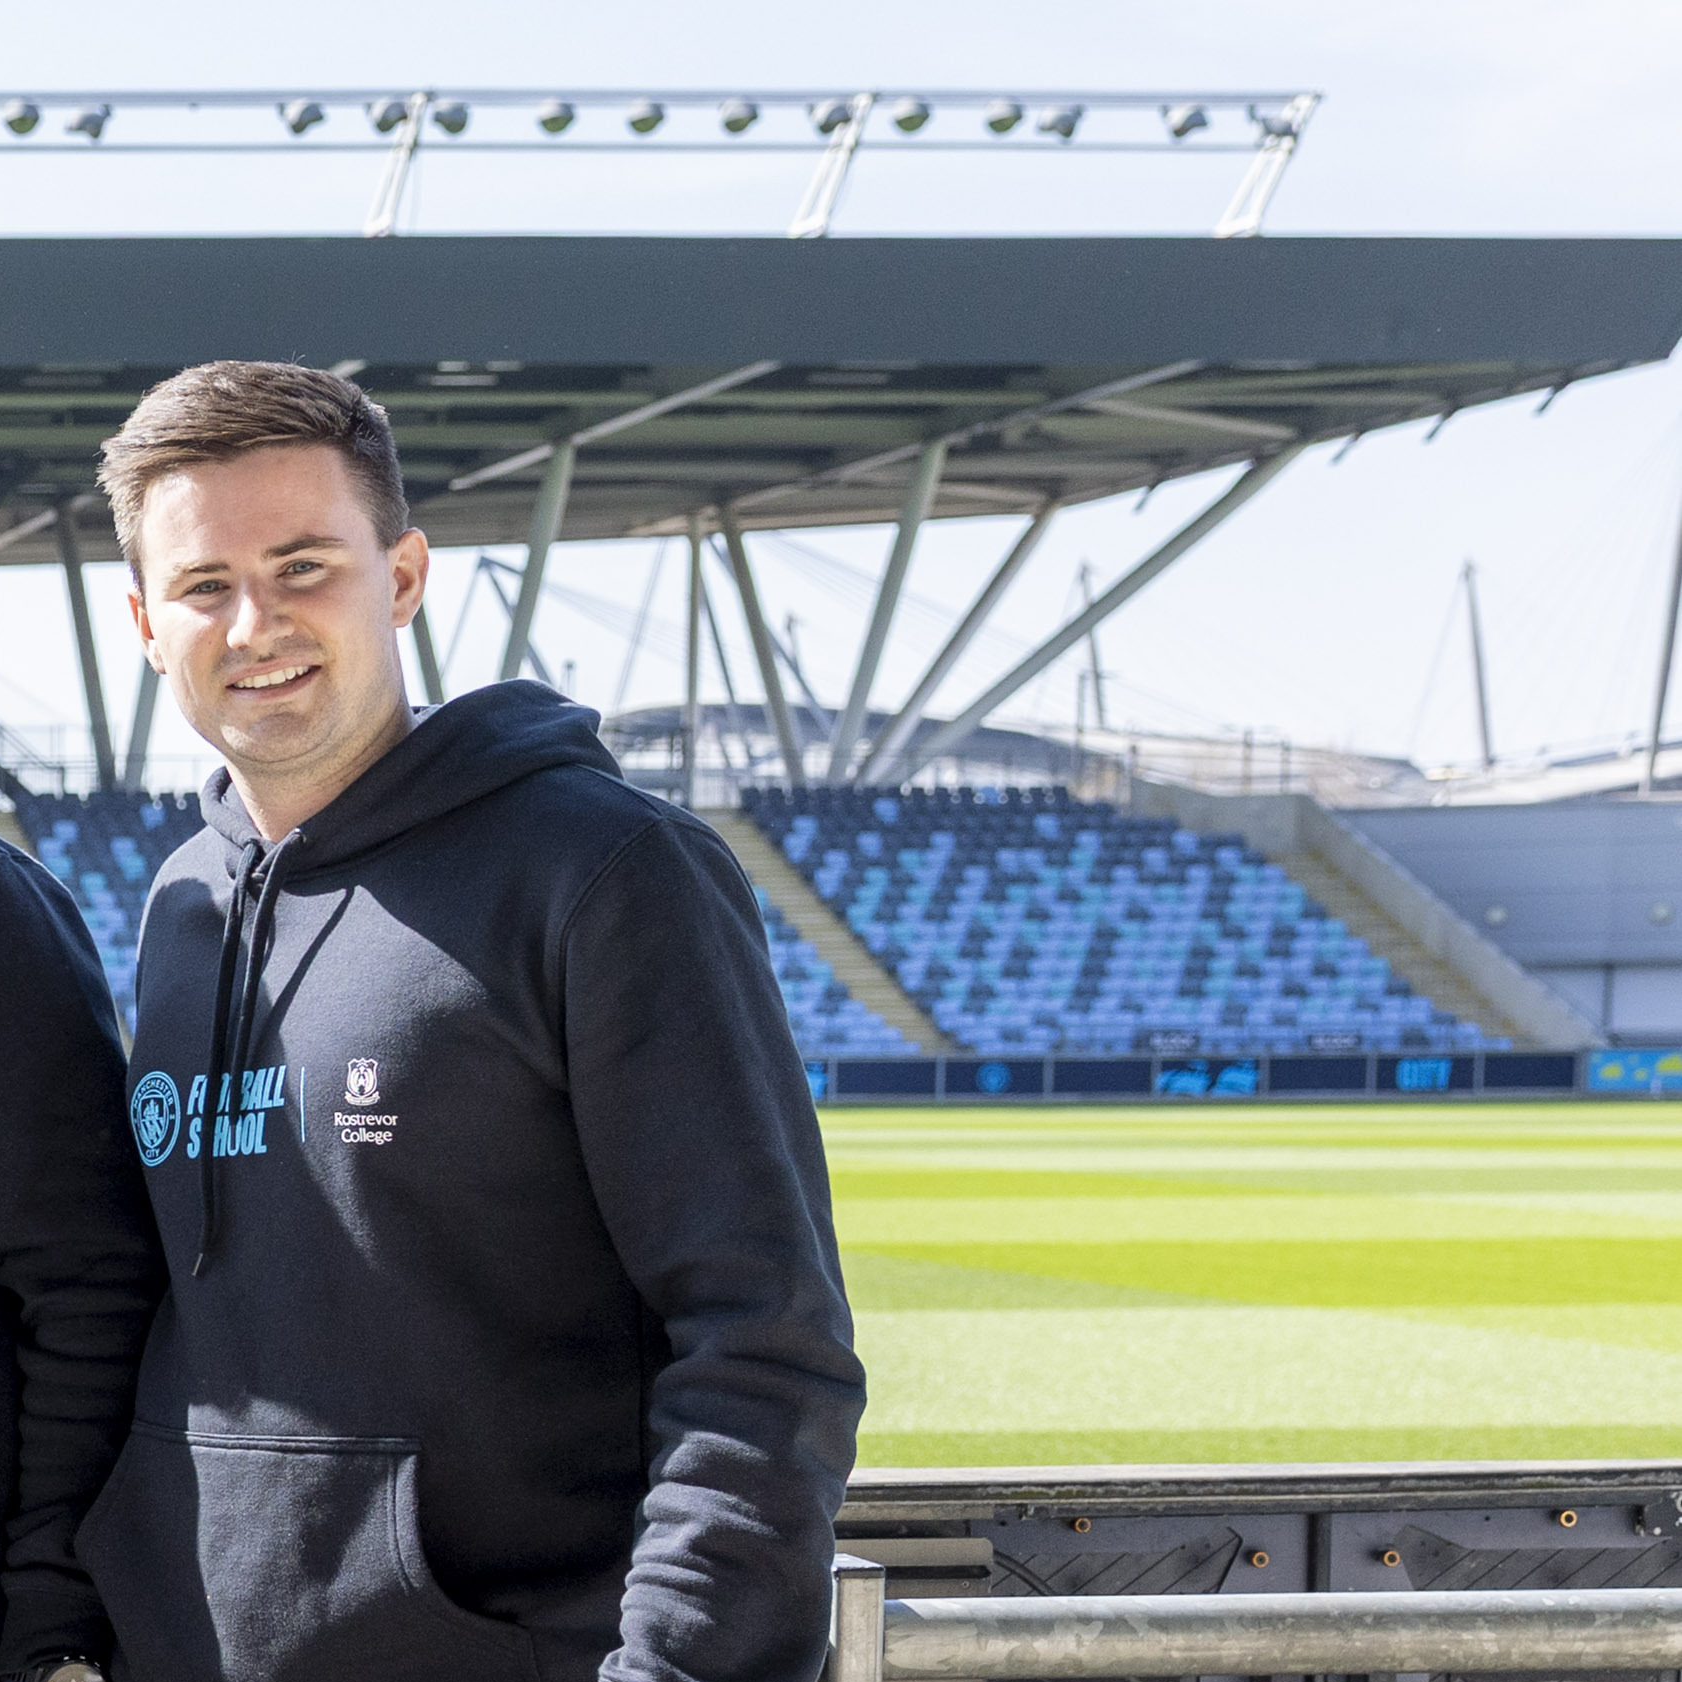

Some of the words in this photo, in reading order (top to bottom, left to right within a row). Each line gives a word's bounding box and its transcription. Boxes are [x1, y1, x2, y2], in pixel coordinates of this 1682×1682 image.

[334, 1112, 398, 1126] Rostrevor
[187, 1112, 267, 1159] SHOOL
[341, 1127, 393, 1145] College
